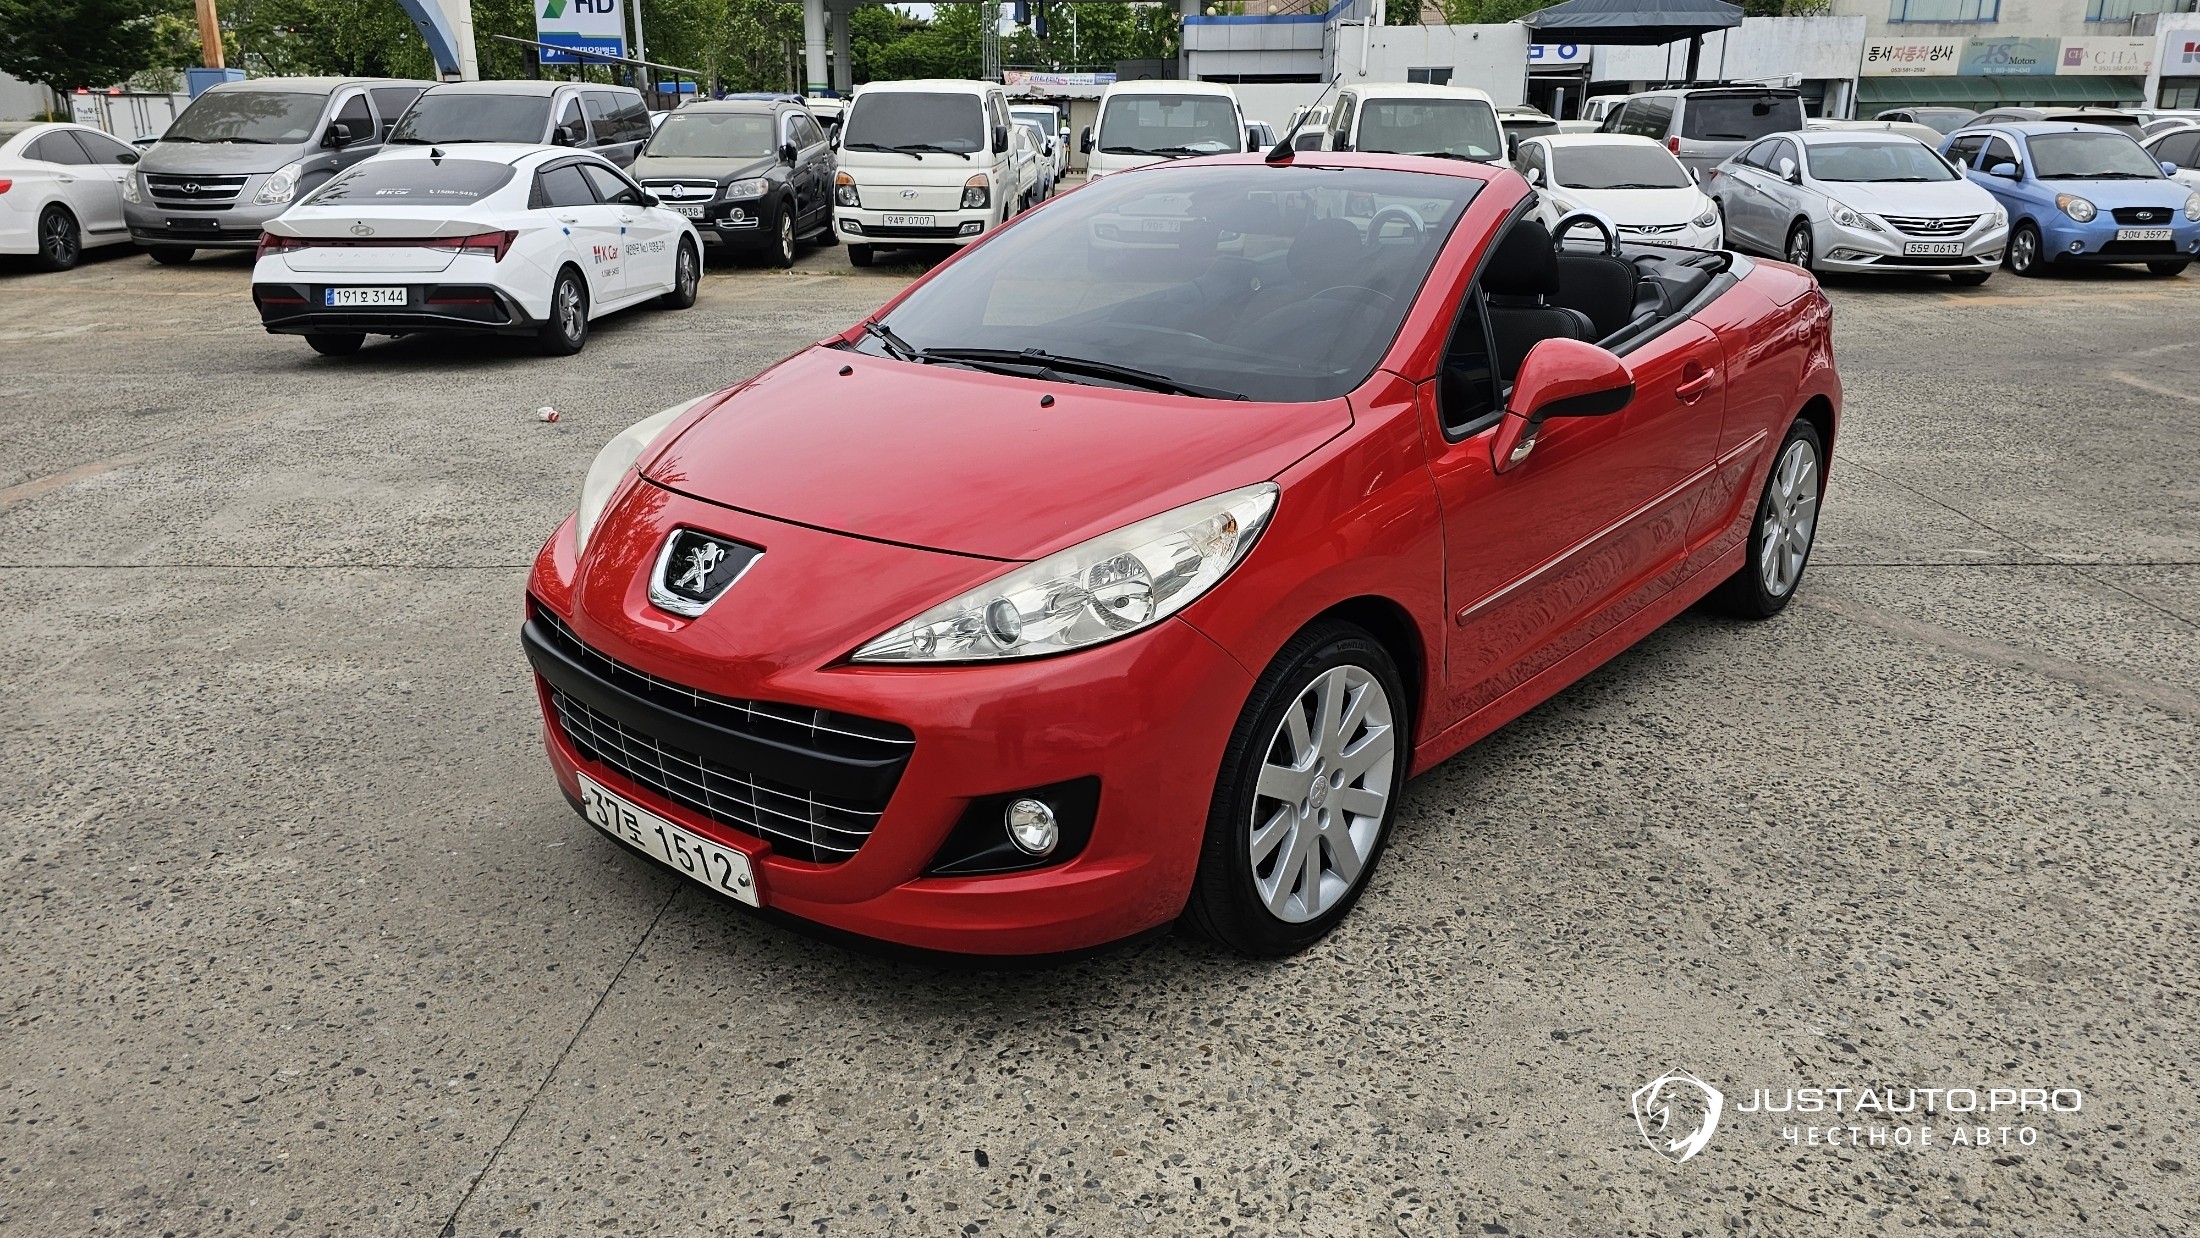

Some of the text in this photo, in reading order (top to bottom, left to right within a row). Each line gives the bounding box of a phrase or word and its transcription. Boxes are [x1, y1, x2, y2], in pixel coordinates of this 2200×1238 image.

[2008, 57, 2036, 65] Motors
[2095, 51, 2138, 64] CHA
[909, 216, 930, 225] 0707
[2144, 230, 2168, 239] 3597
[1933, 244, 1958, 253] 0613
[336, 290, 403, 303] 191호 3144
[591, 788, 738, 894] 37로 1512
